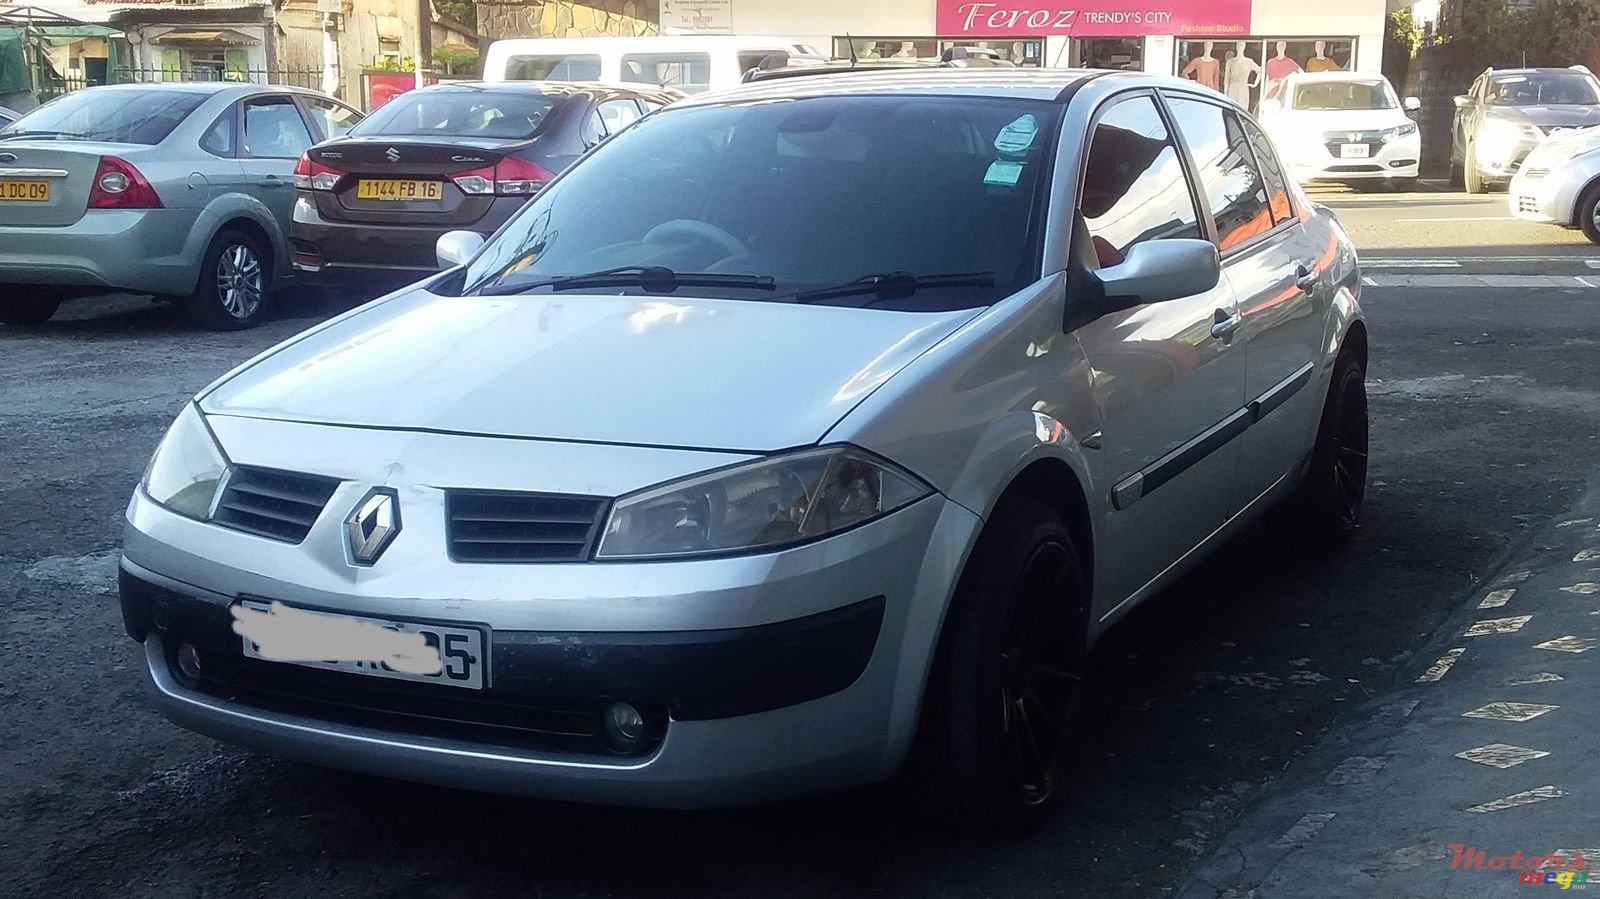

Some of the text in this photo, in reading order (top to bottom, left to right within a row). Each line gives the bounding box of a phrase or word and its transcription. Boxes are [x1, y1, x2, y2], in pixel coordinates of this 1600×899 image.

[958, 3, 1075, 31] Feroz
[1084, 12, 1172, 24] TRENDY'S CITY
[1181, 25, 1244, 33] Fashion Studio
[9, 184, 26, 198] DC
[30, 184, 47, 198] 09
[366, 181, 437, 197] 1144 FB 16
